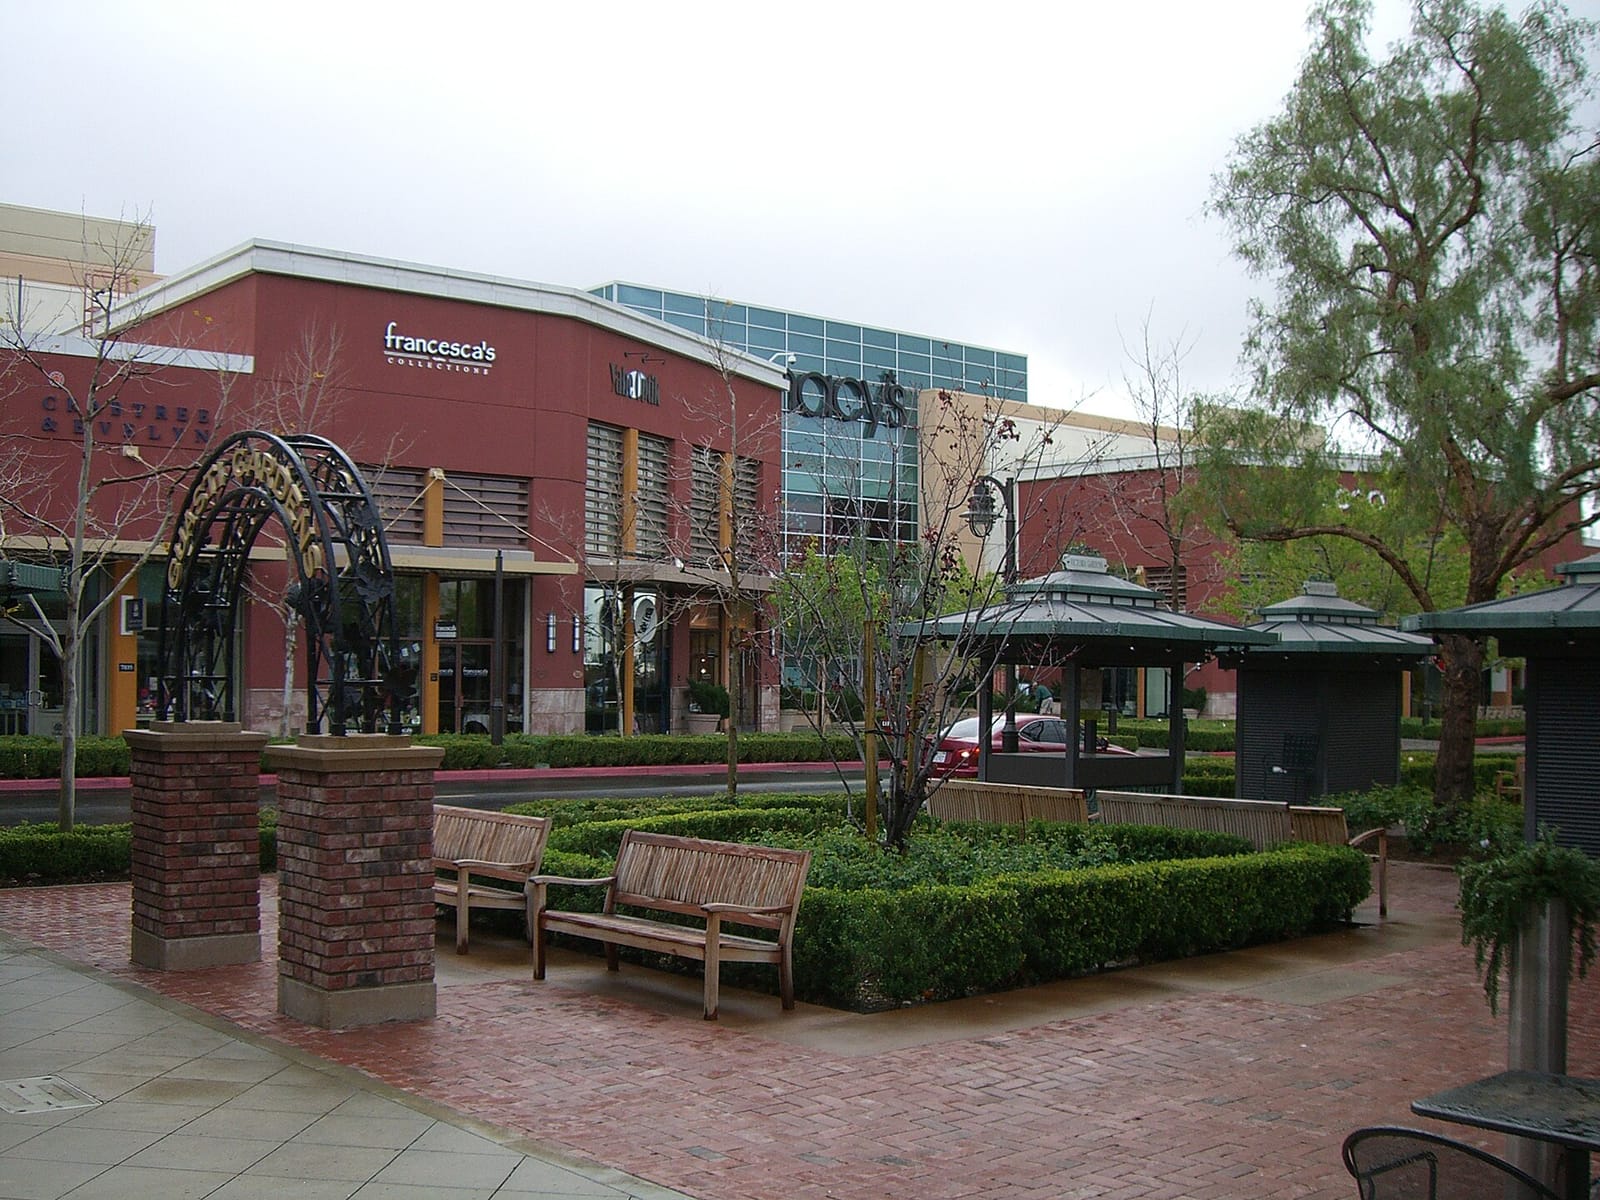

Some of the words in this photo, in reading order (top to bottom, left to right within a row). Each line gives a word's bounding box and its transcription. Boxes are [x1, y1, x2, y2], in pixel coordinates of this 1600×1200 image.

[385, 321, 497, 361] francesca's
[387, 357, 489, 375] COLLECTIONS
[784, 368, 908, 439] acy's
[74, 419, 211, 444] EVELYN
